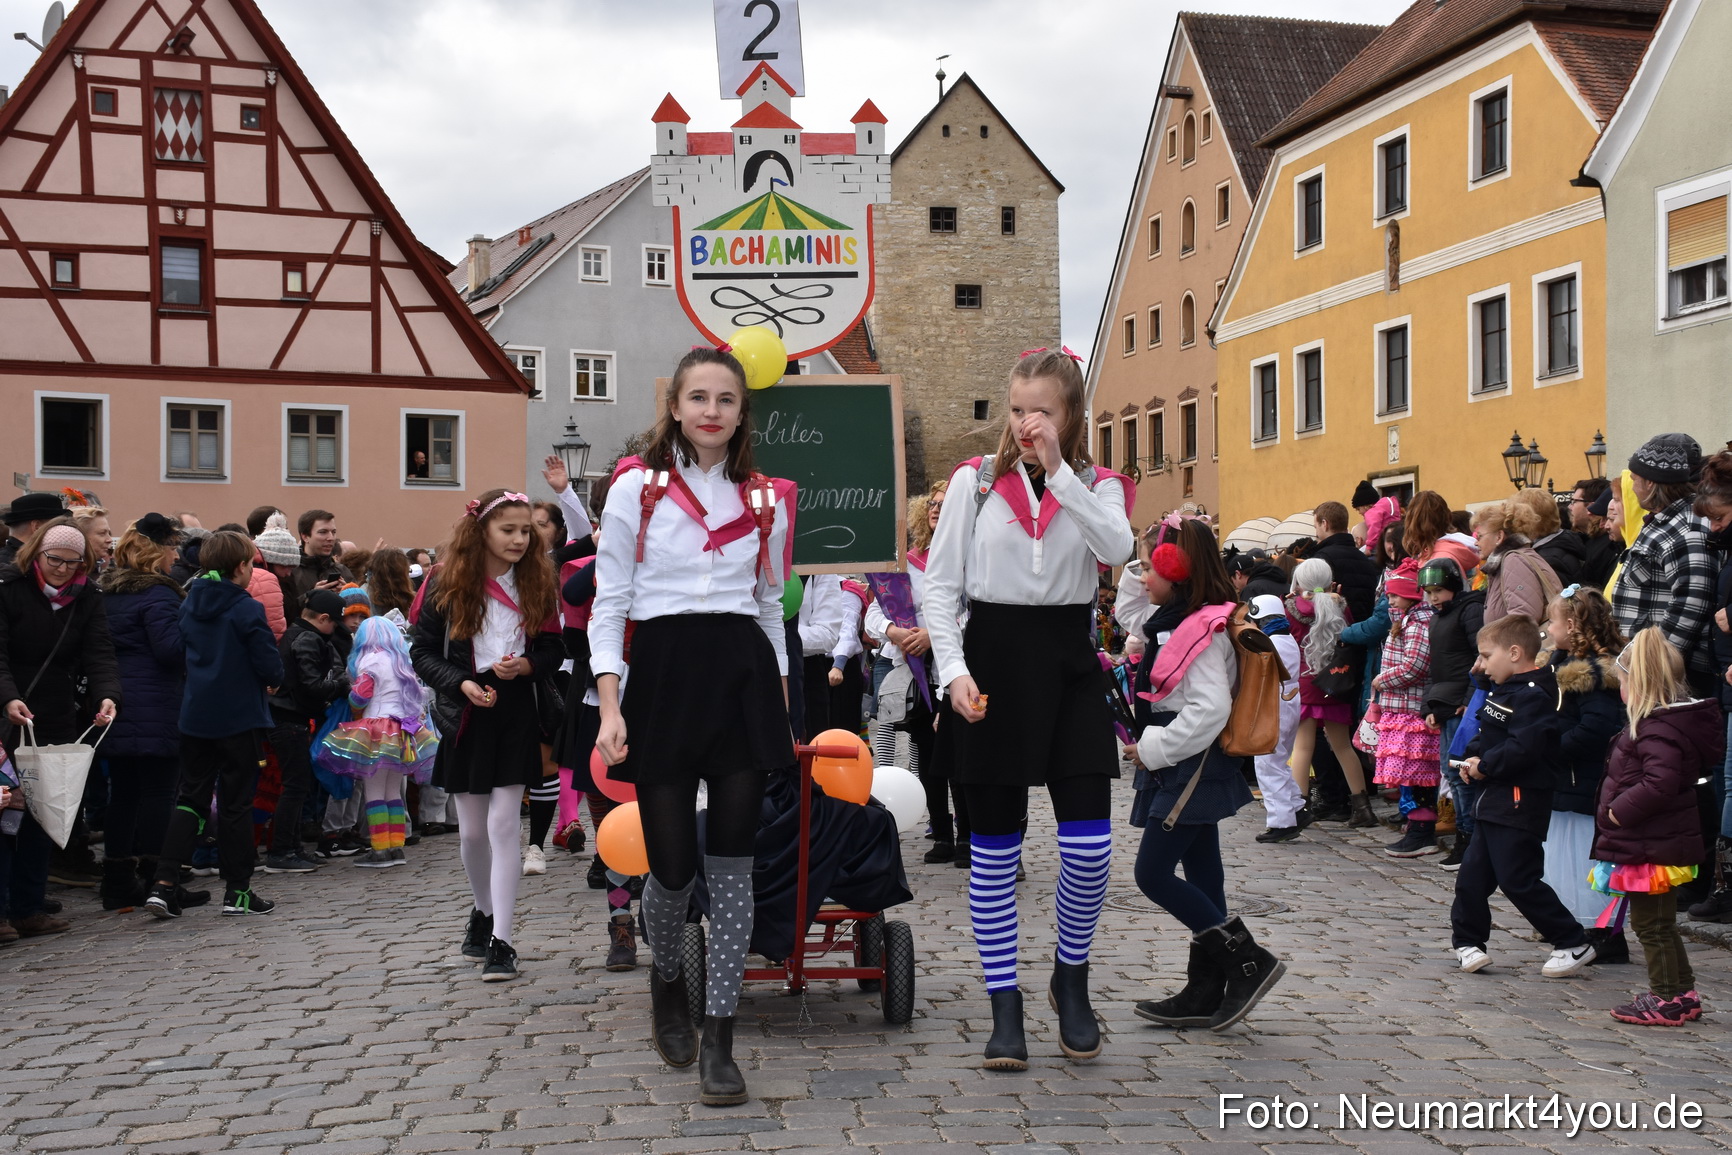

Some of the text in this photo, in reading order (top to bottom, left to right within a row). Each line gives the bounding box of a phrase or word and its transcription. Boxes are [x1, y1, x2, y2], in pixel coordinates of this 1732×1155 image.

[742, 0, 781, 61] 2
[690, 234, 859, 266] BACHAMINIS
[750, 410, 824, 447] obiles
[797, 472, 889, 512] zimmer
[1483, 704, 1507, 722] POLICE
